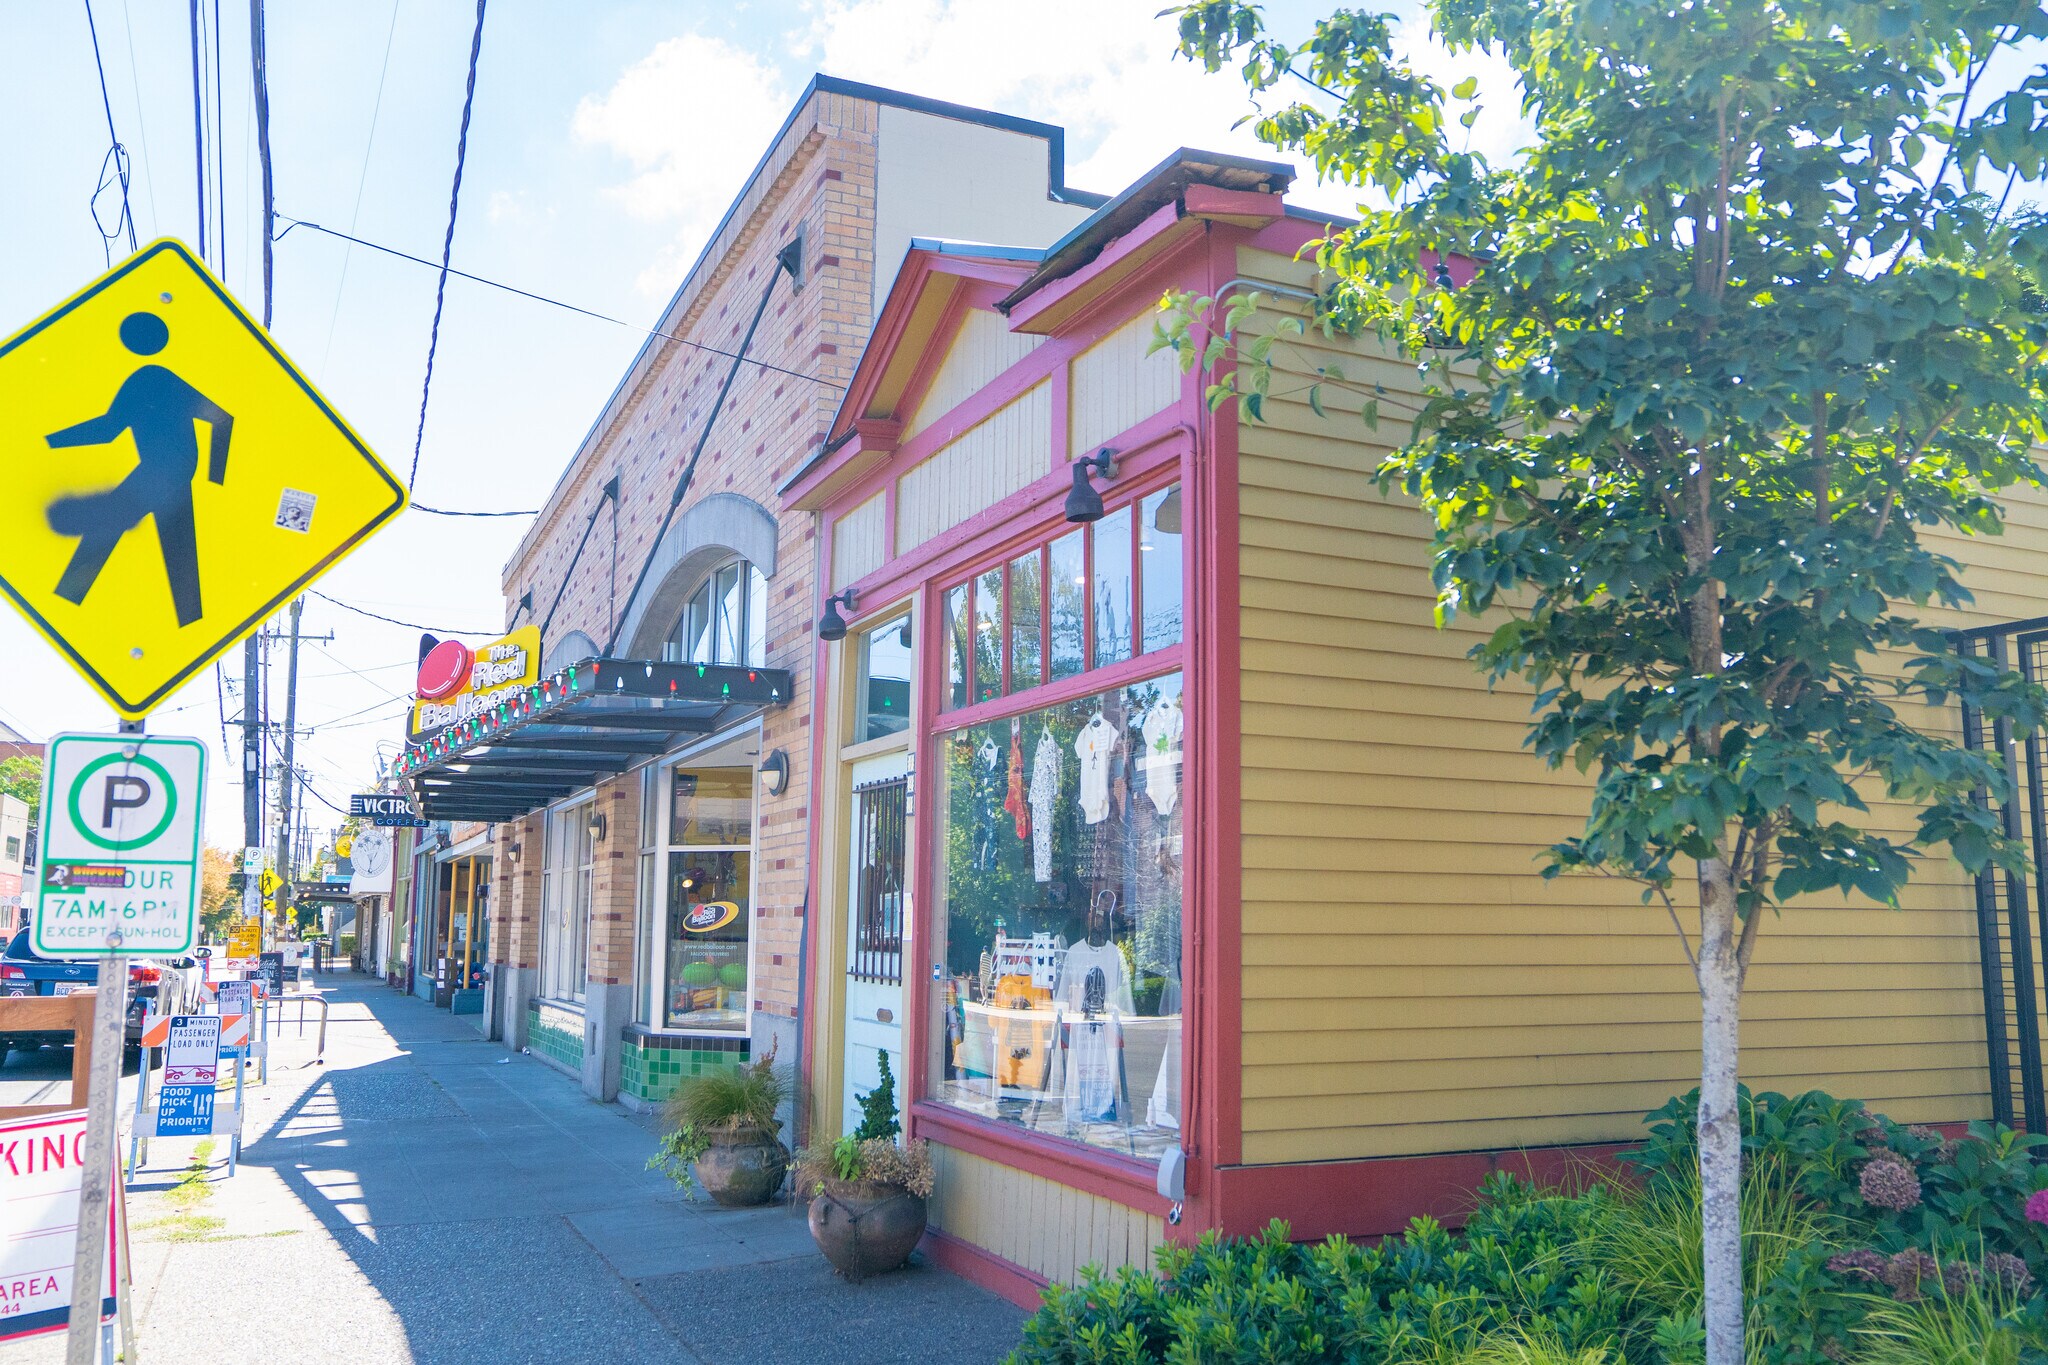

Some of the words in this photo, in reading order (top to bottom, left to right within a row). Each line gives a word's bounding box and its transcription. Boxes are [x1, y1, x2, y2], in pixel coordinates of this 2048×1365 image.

[488, 644, 520, 662] The
[471, 650, 527, 691] Red
[419, 684, 525, 732] Balloon
[102, 776, 151, 828] P
[124, 870, 173, 889] OUR
[46, 926, 106, 937] EXCEPT
[115, 928, 181, 938] SUN-HOL
[256, 970, 274, 978] OPN
[176, 1018, 183, 1026] 3
[174, 1029, 216, 1037] PASSENGER
[173, 1040, 192, 1048] LOAD
[163, 1088, 192, 1096] FOOD
[161, 1098, 192, 1106] PICK-
[161, 1108, 176, 1116] UP
[160, 1117, 210, 1126] PRIORITY
